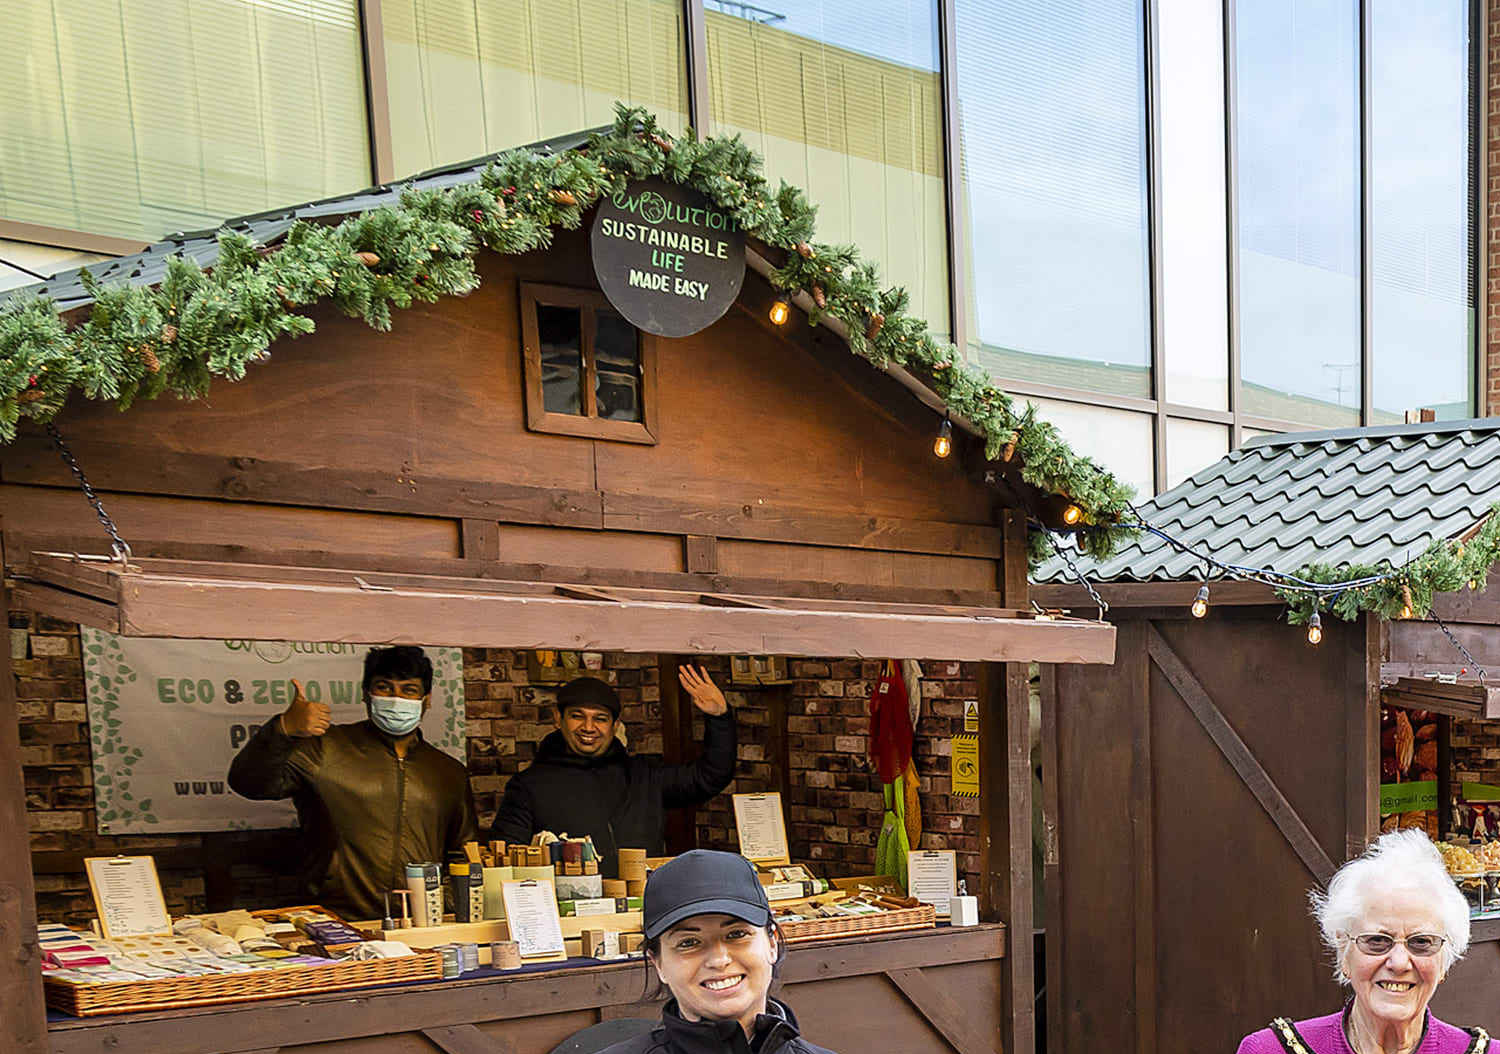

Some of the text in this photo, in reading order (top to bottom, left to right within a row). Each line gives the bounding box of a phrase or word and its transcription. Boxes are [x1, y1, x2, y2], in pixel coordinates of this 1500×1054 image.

[602, 218, 729, 259] SUSTAINABLE
[652, 250, 686, 273] LIFE
[629, 269, 709, 301] MADE EASY
[157, 678, 215, 704] ECO
[224, 679, 244, 704] &
